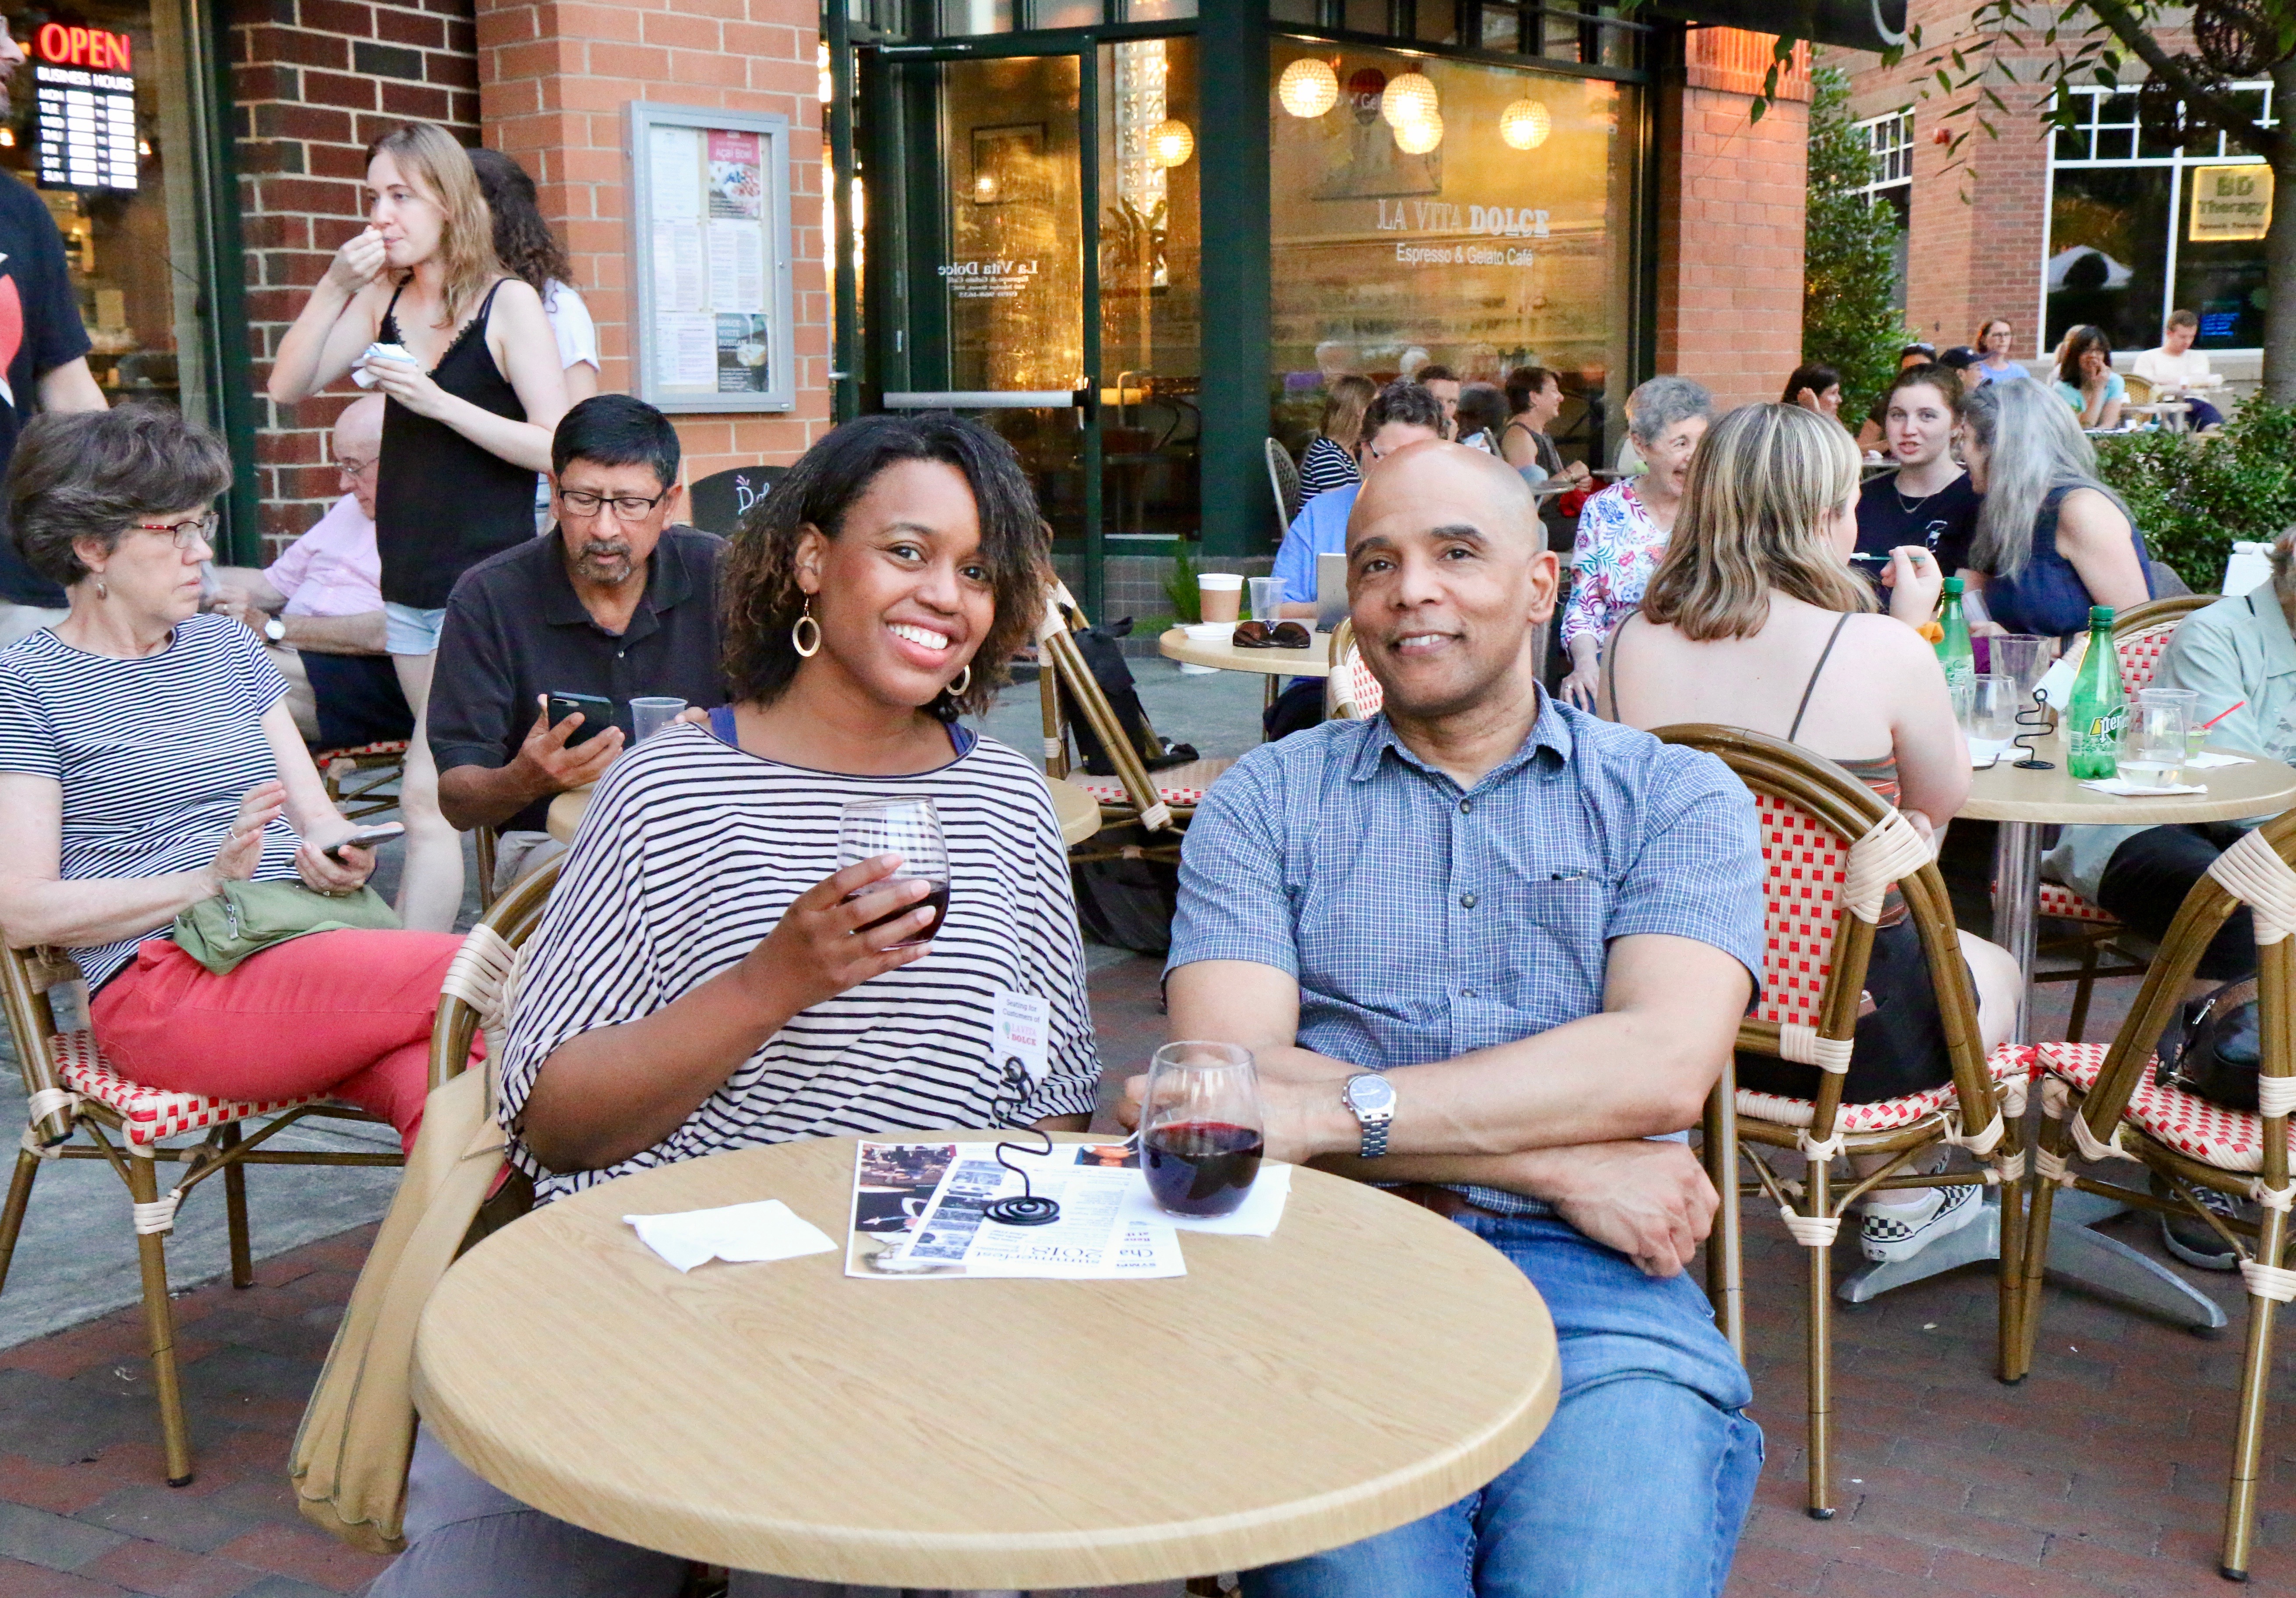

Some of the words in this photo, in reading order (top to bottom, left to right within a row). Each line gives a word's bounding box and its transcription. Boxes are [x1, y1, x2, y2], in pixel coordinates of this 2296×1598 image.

[40, 23, 130, 71] OPEN
[37, 66, 92, 86] BUSINESS
[92, 74, 134, 92] HOURS
[39, 88, 65, 101] MON
[40, 115, 65, 129] WED
[42, 156, 61, 169] SAT
[42, 170, 65, 183] SUN
[1376, 198, 1408, 231] LA
[1413, 201, 1462, 233] VITA
[1468, 205, 1550, 238] DOLCE
[1396, 242, 1452, 266] Espresso
[1454, 245, 1464, 263] &
[1467, 245, 1504, 265] Gelato
[1507, 247, 1533, 266] Café
[1006, 999, 1027, 1011] Seating
[1002, 1008, 1033, 1021] Customers
[1012, 1033, 1037, 1046] DOLCE
[973, 1252, 1101, 1264] summerfest
[1031, 1246, 1104, 1259] 2018
